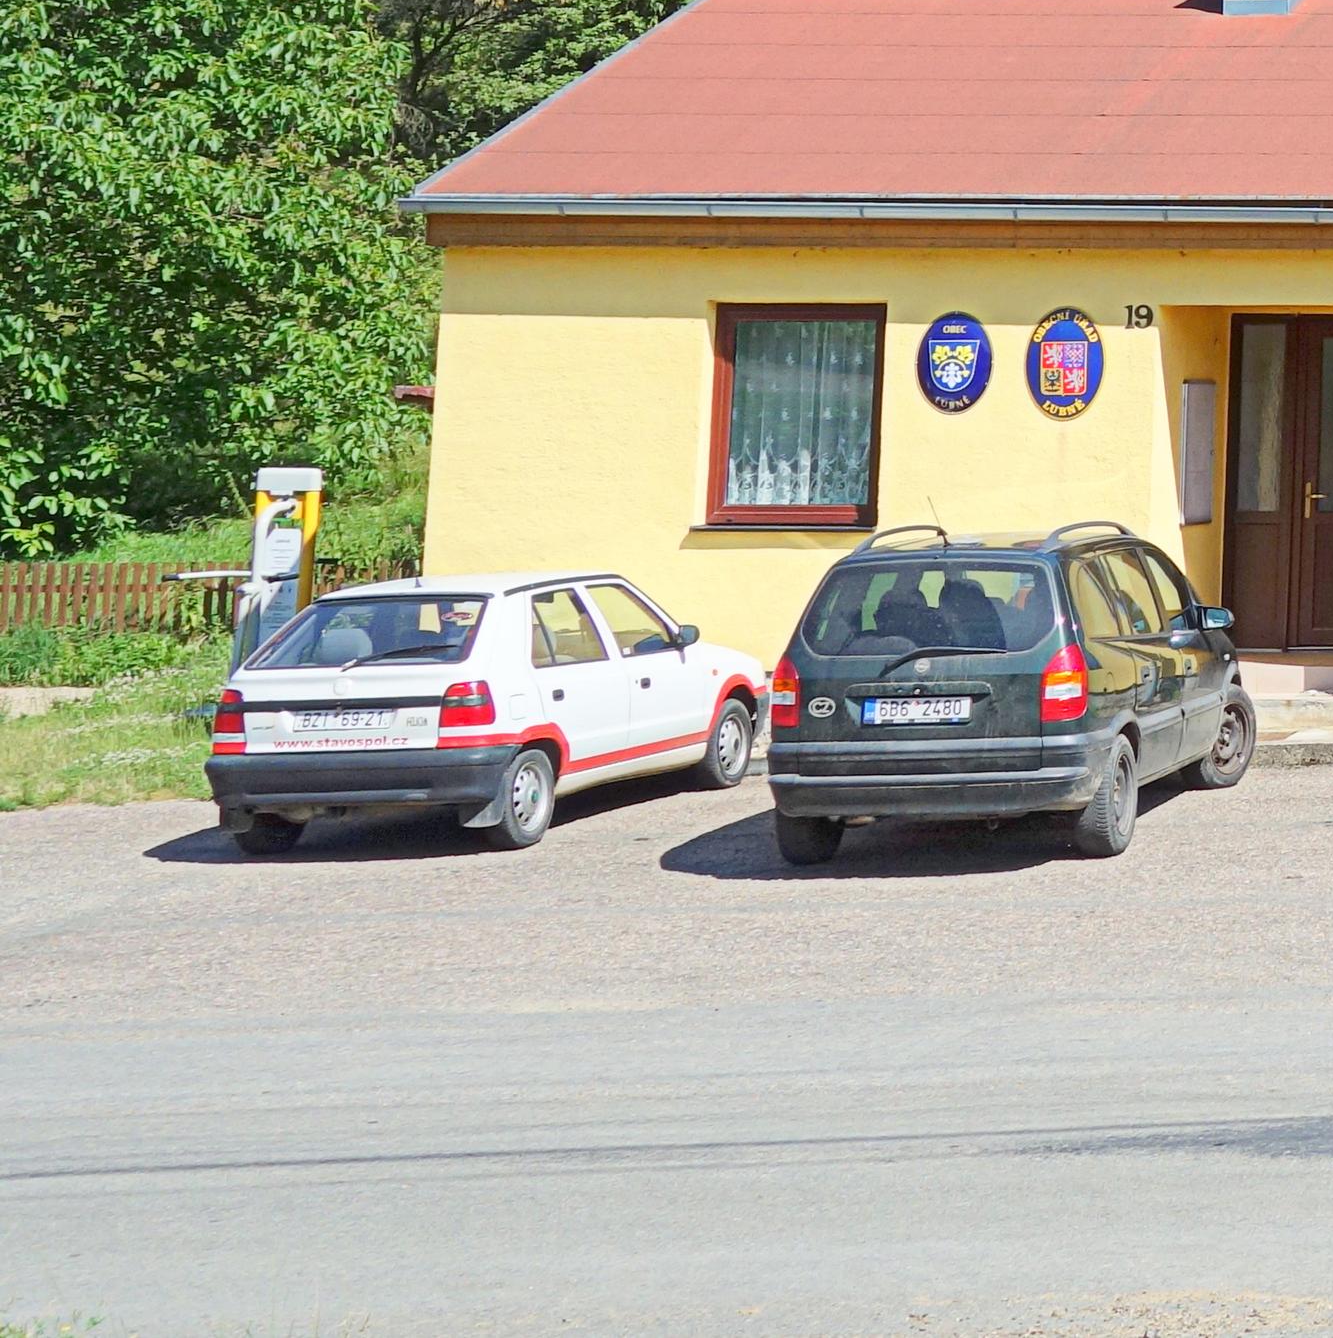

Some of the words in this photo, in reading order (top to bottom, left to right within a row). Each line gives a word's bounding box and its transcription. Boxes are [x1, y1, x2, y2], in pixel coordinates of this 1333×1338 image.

[1124, 304, 1154, 329] 19
[942, 325, 967, 334] OBEC
[1033, 309, 1070, 342] OBECNÍ
[1042, 397, 1086, 416] LUBNÉ
[812, 701, 830, 713] CZ
[879, 700, 909, 717] 6B6
[922, 699, 962, 716] 2480
[340, 710, 385, 727] 69-21
[273, 735, 409, 750] www.stavospol.cz
